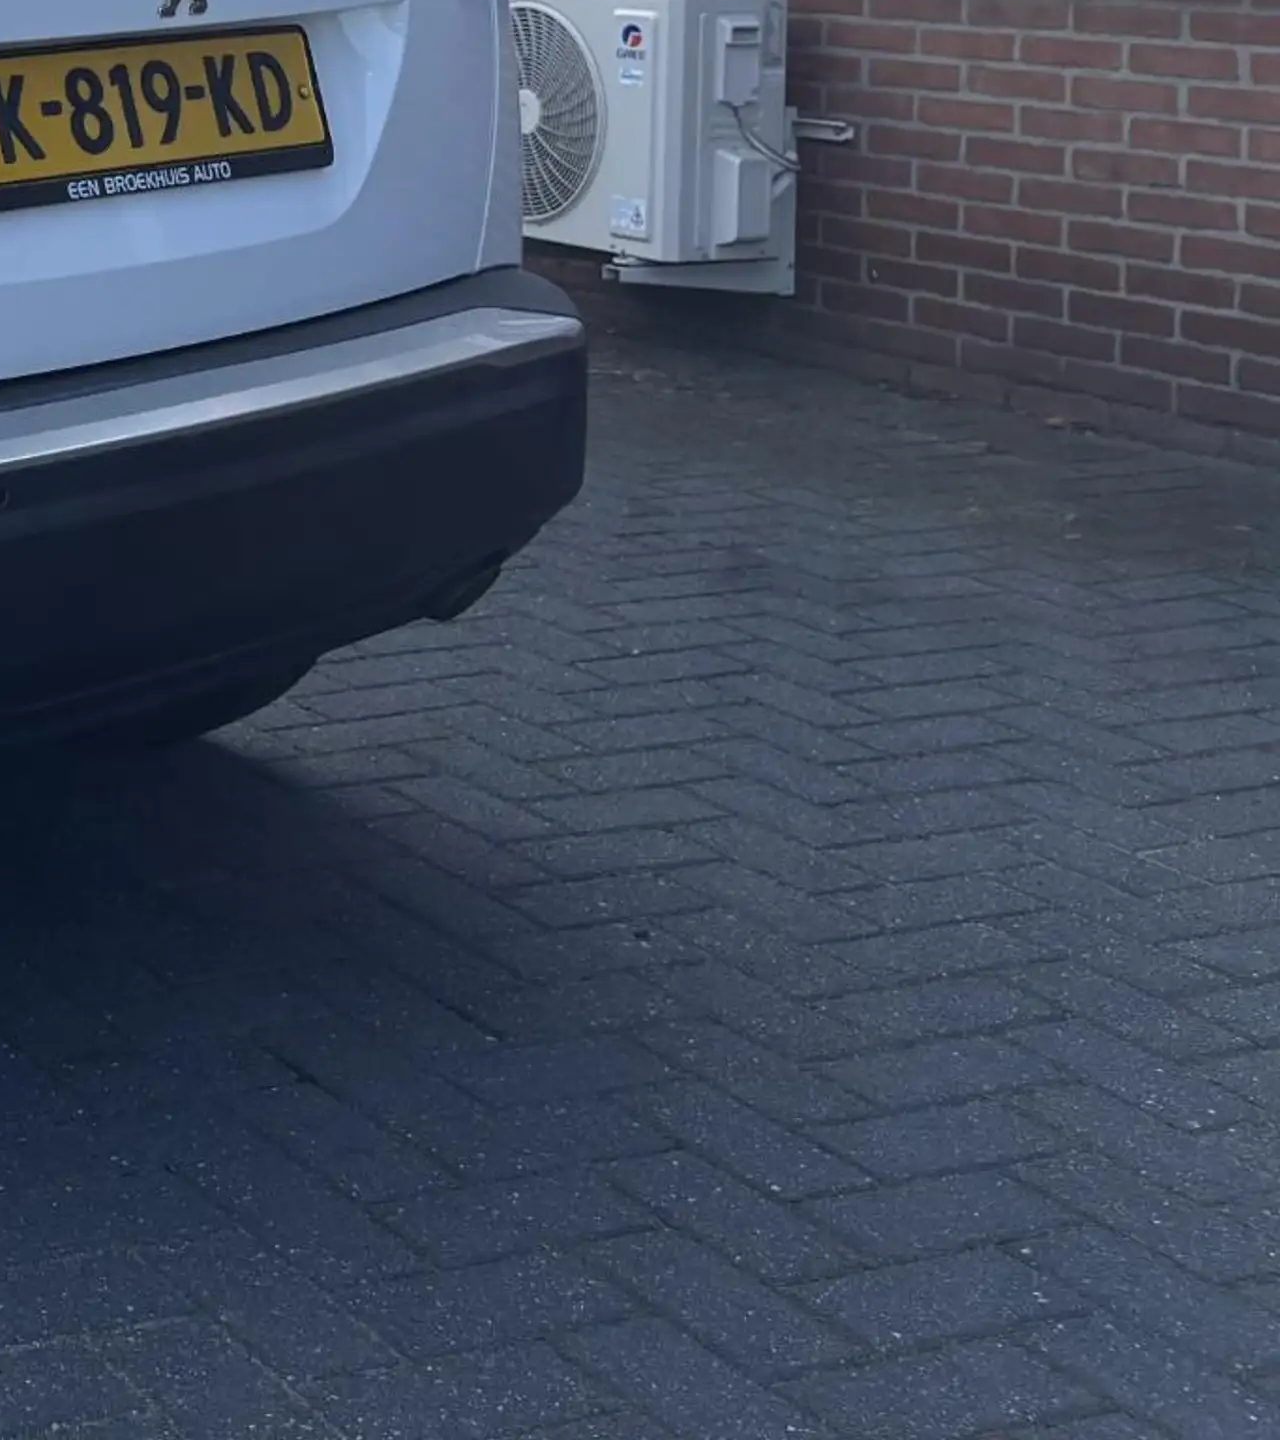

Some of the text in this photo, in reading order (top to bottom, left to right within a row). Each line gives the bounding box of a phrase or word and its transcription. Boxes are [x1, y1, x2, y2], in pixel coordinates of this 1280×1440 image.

[67, 160, 232, 200] EEN BROEKHUIS AUTO
